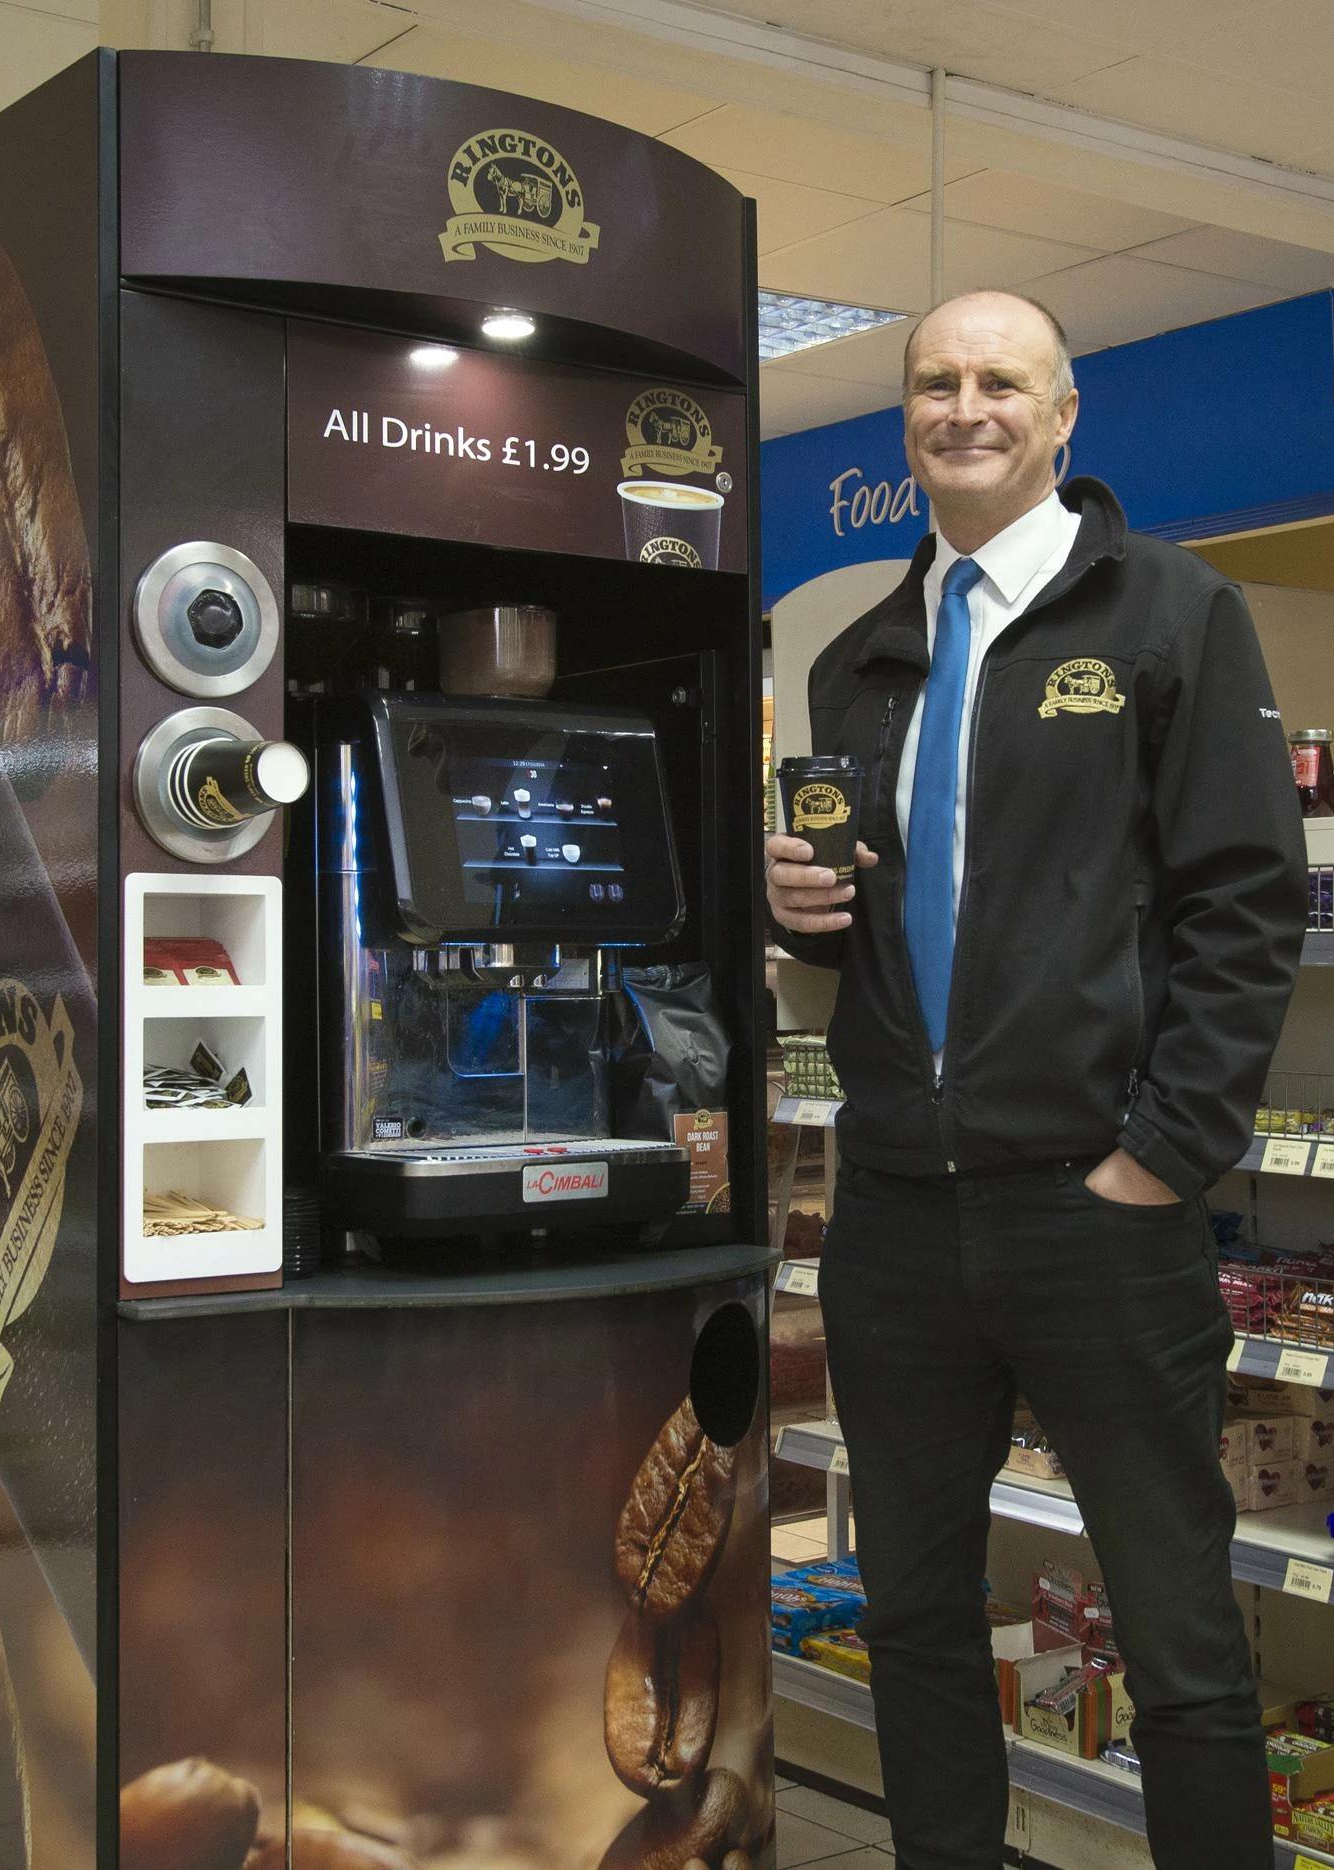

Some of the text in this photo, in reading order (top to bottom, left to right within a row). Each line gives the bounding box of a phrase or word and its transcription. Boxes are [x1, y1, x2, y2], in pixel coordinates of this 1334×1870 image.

[450, 134, 582, 210] RINGTONS
[454, 221, 584, 257] A FAMILY BUSINESS SINCE 1907
[627, 390, 710, 438] RINGTONS
[323, 409, 591, 475] All Drinks £1.99
[635, 447, 655, 460] FAMILY
[655, 448, 683, 464] BUSINESS
[683, 454, 700, 466] SINCE
[828, 468, 921, 536] Food
[1047, 661, 1116, 688] RINGTONS
[794, 785, 844, 806] RINGTONS
[686, 1131, 720, 1142] DARK ROAST
[695, 1142, 712, 1152] BEAN
[538, 1169, 605, 1196] CIMBALI
[2, 1176, 44, 1275] BUSINESS
[36, 1126, 68, 1193] SINCE
